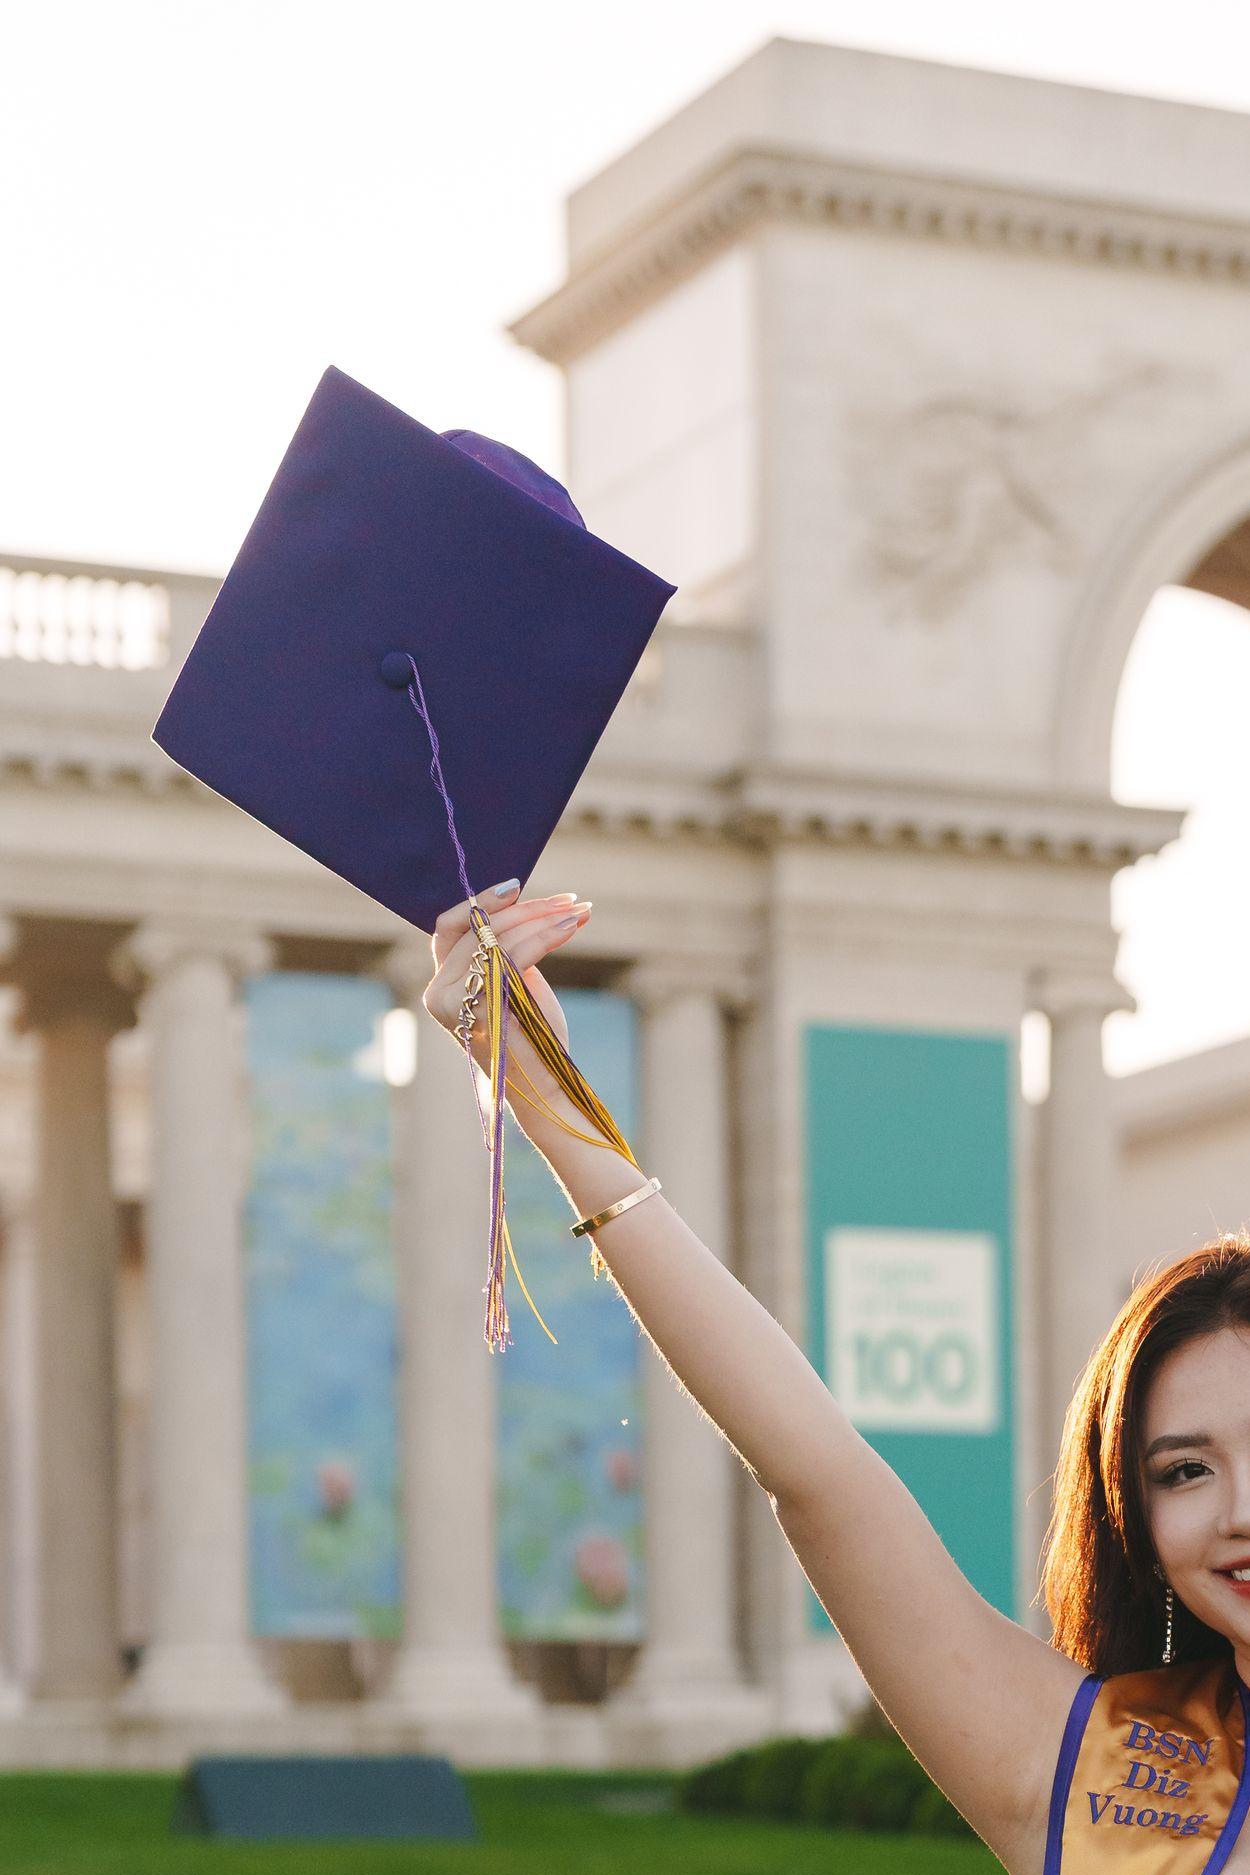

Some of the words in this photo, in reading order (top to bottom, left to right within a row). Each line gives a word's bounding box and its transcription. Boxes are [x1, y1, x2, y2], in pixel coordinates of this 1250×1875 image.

[853, 1327, 979, 1409] 100
[1122, 1718, 1214, 1767] BSN
[1121, 1759, 1191, 1800] Diz
[1086, 1791, 1209, 1836] Vuong
